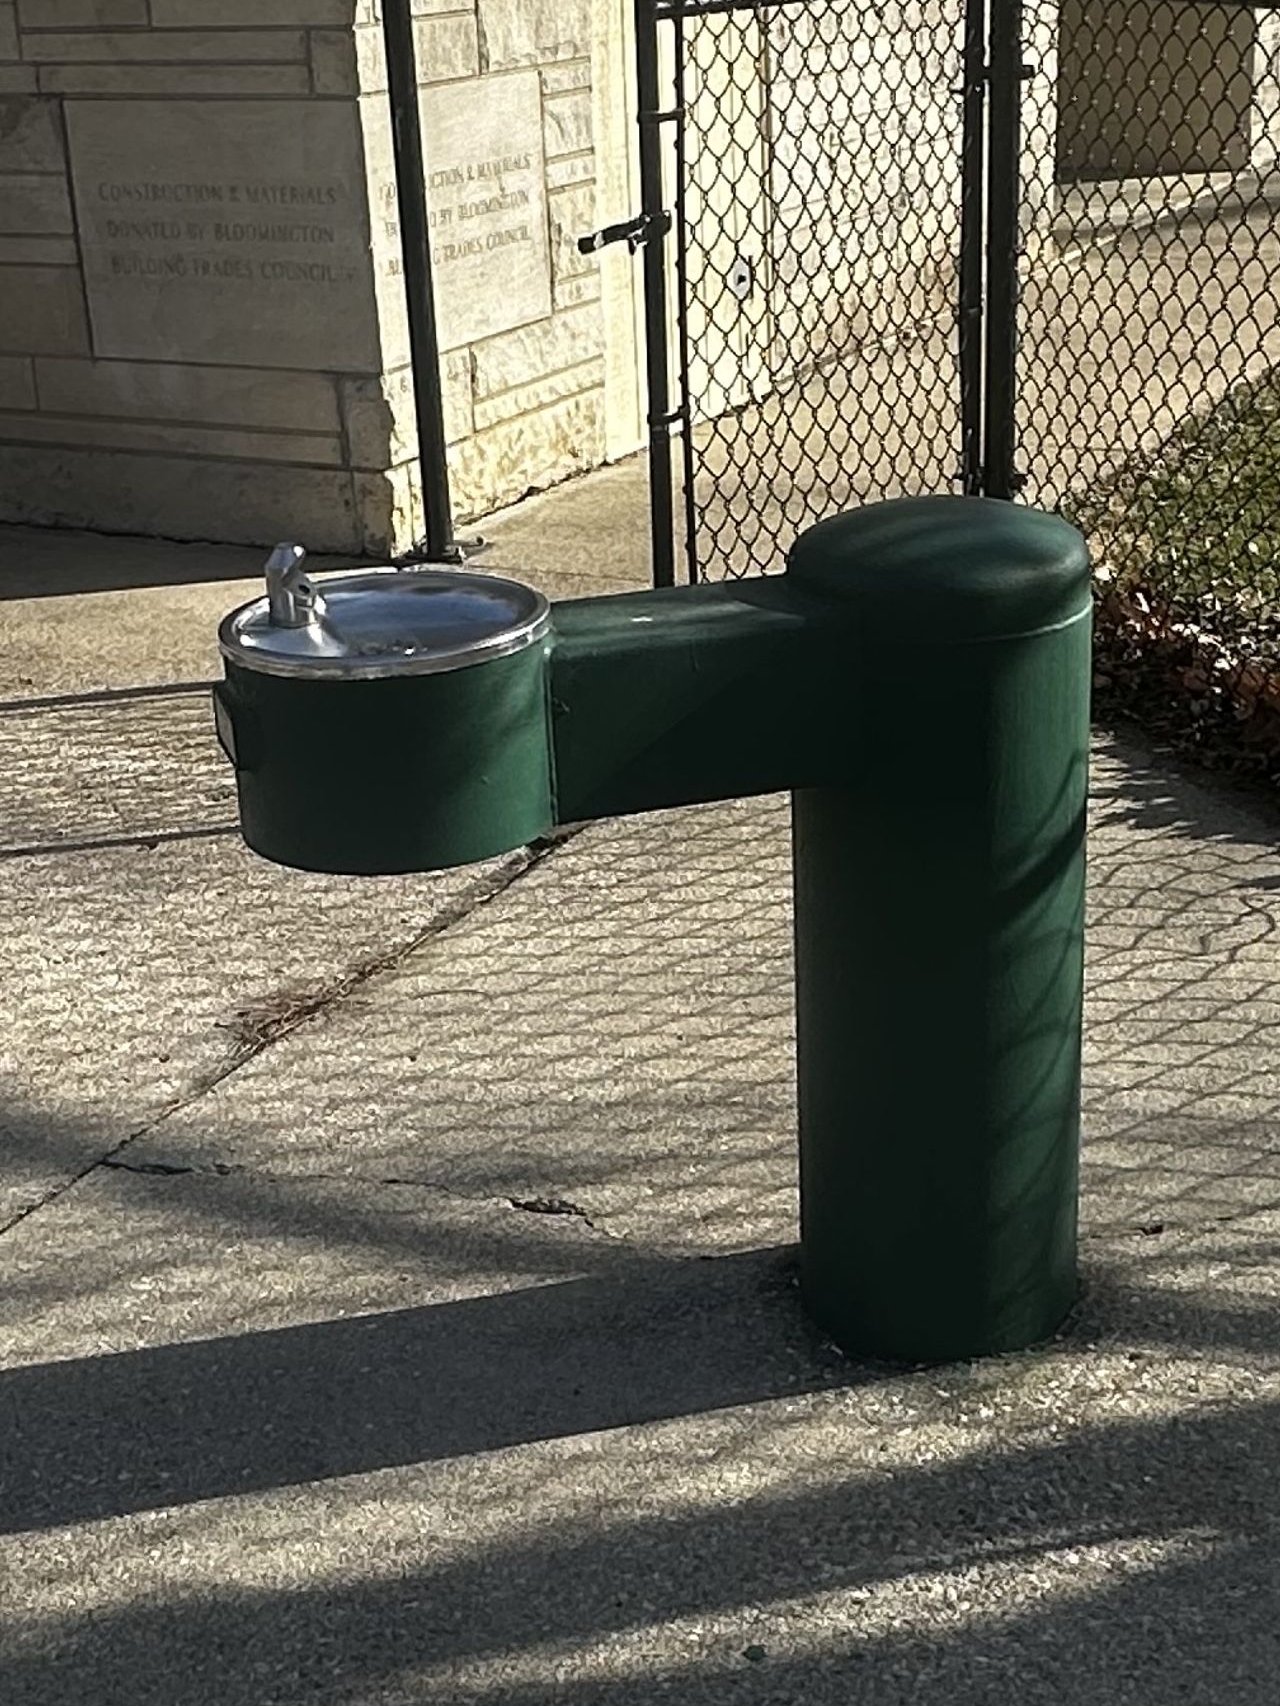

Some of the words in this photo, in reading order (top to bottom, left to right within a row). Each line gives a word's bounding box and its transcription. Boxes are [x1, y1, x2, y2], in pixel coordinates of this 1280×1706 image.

[98, 182, 222, 203] CONSTRUCTION
[245, 184, 337, 205] MATERIALS
[106, 219, 182, 240] DONATED
[215, 222, 334, 243] BLOOMINGTON
[111, 255, 187, 277] BUILDING
[192, 258, 252, 278] TRADES
[261, 261, 338, 282] COUNCIL
